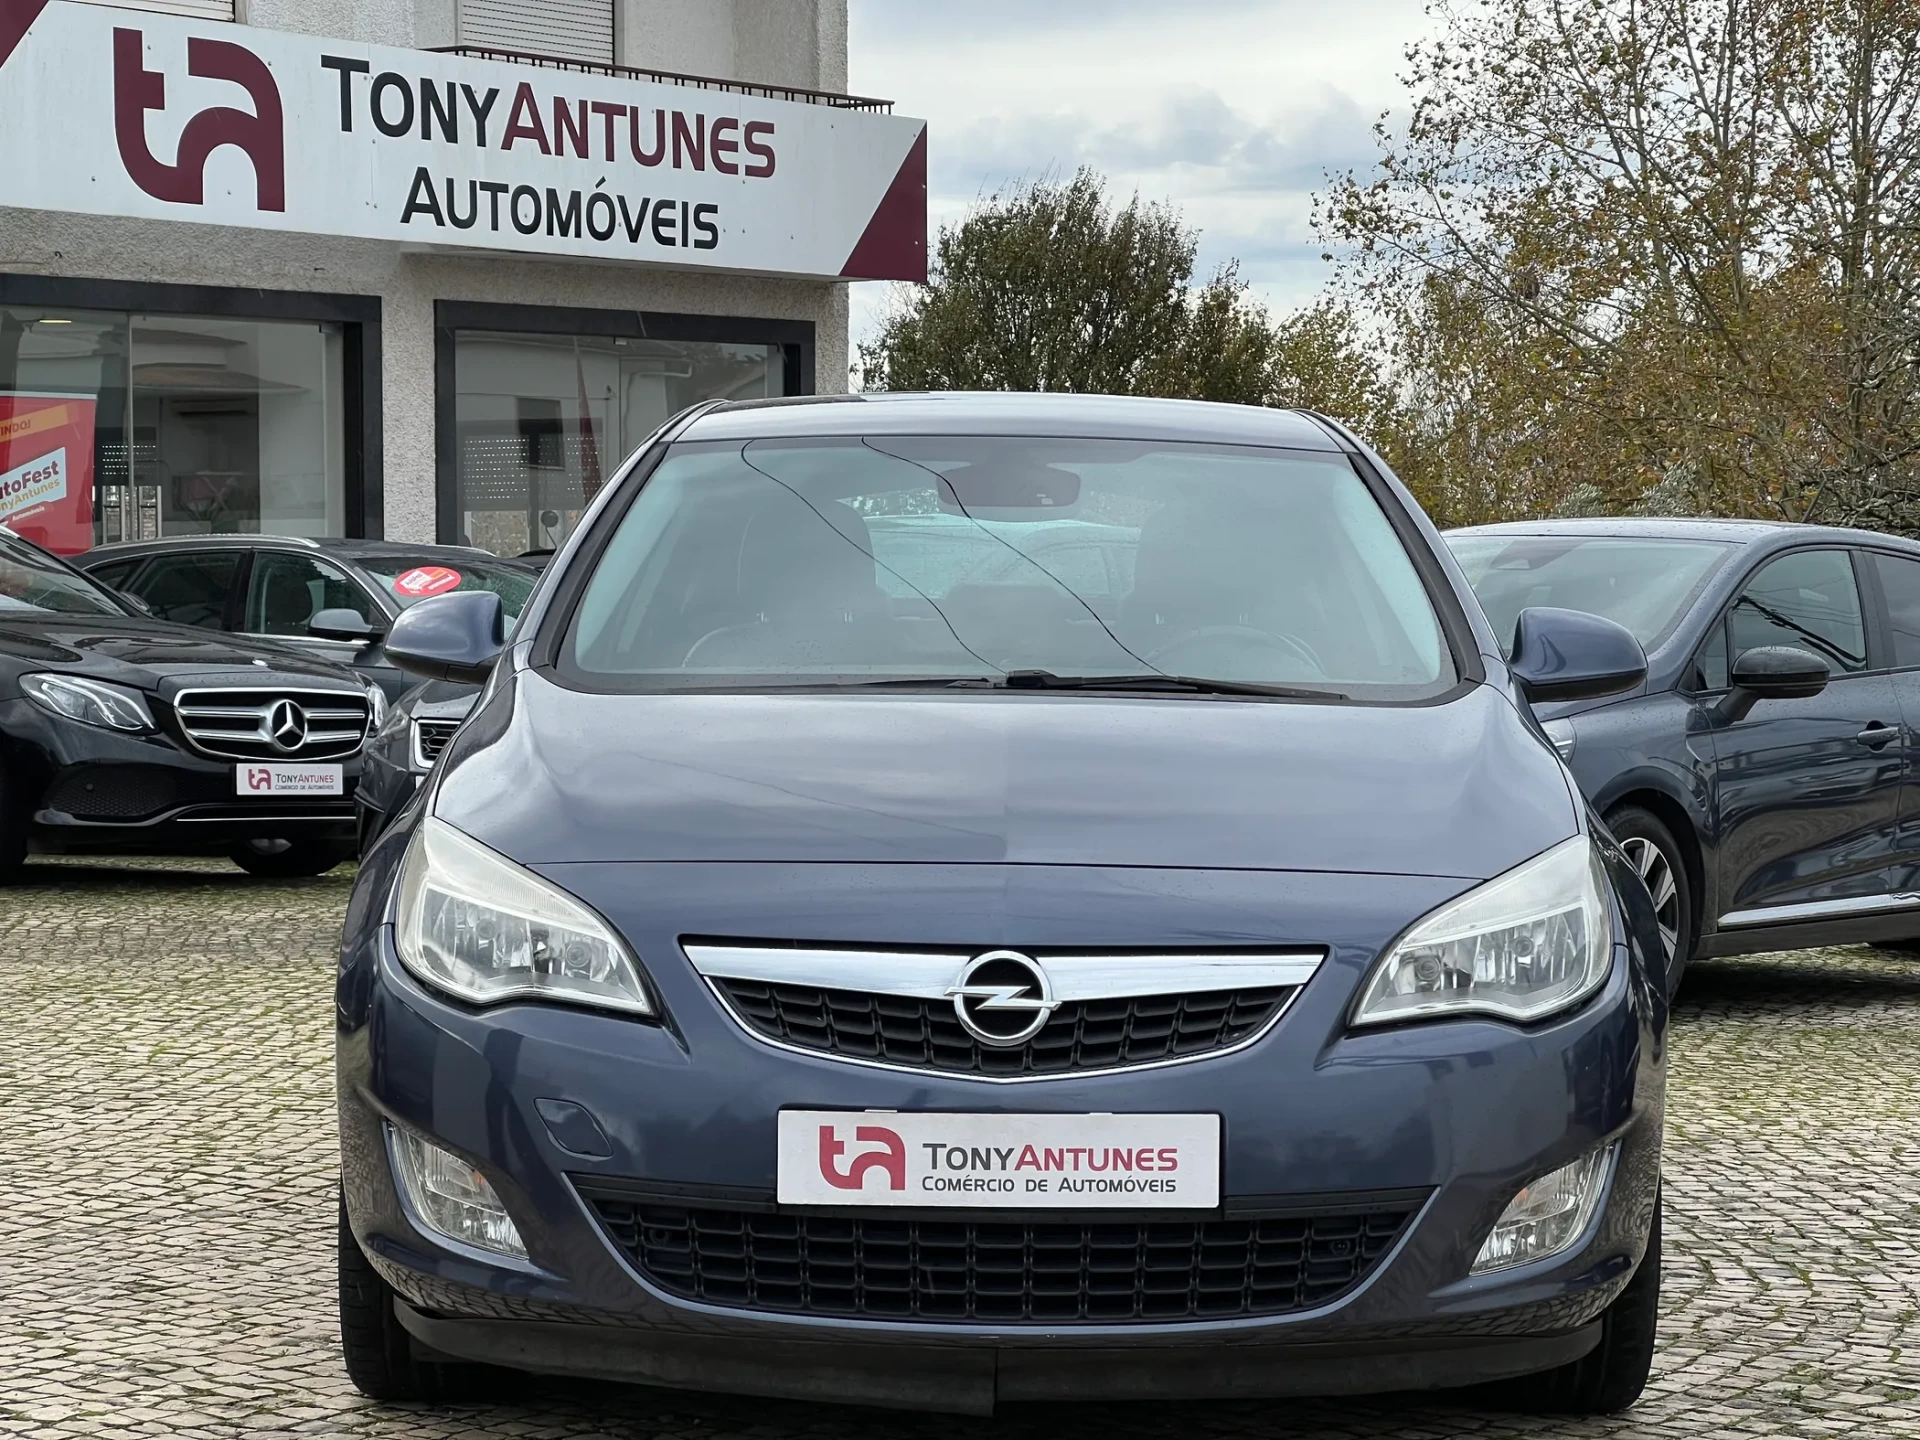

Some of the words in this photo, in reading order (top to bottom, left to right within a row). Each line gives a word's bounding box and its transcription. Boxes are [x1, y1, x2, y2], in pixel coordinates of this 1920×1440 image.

[400, 166, 719, 250] AUTOMÓVEIS
[0, 419, 31, 436] INDO!
[0, 479, 60, 511] nyAntunes
[922, 1174, 1015, 1192] COMÉRCIO
[1025, 1178, 1048, 1192] DE
[1058, 1175, 1177, 1192] AUTOMÓVEIS
